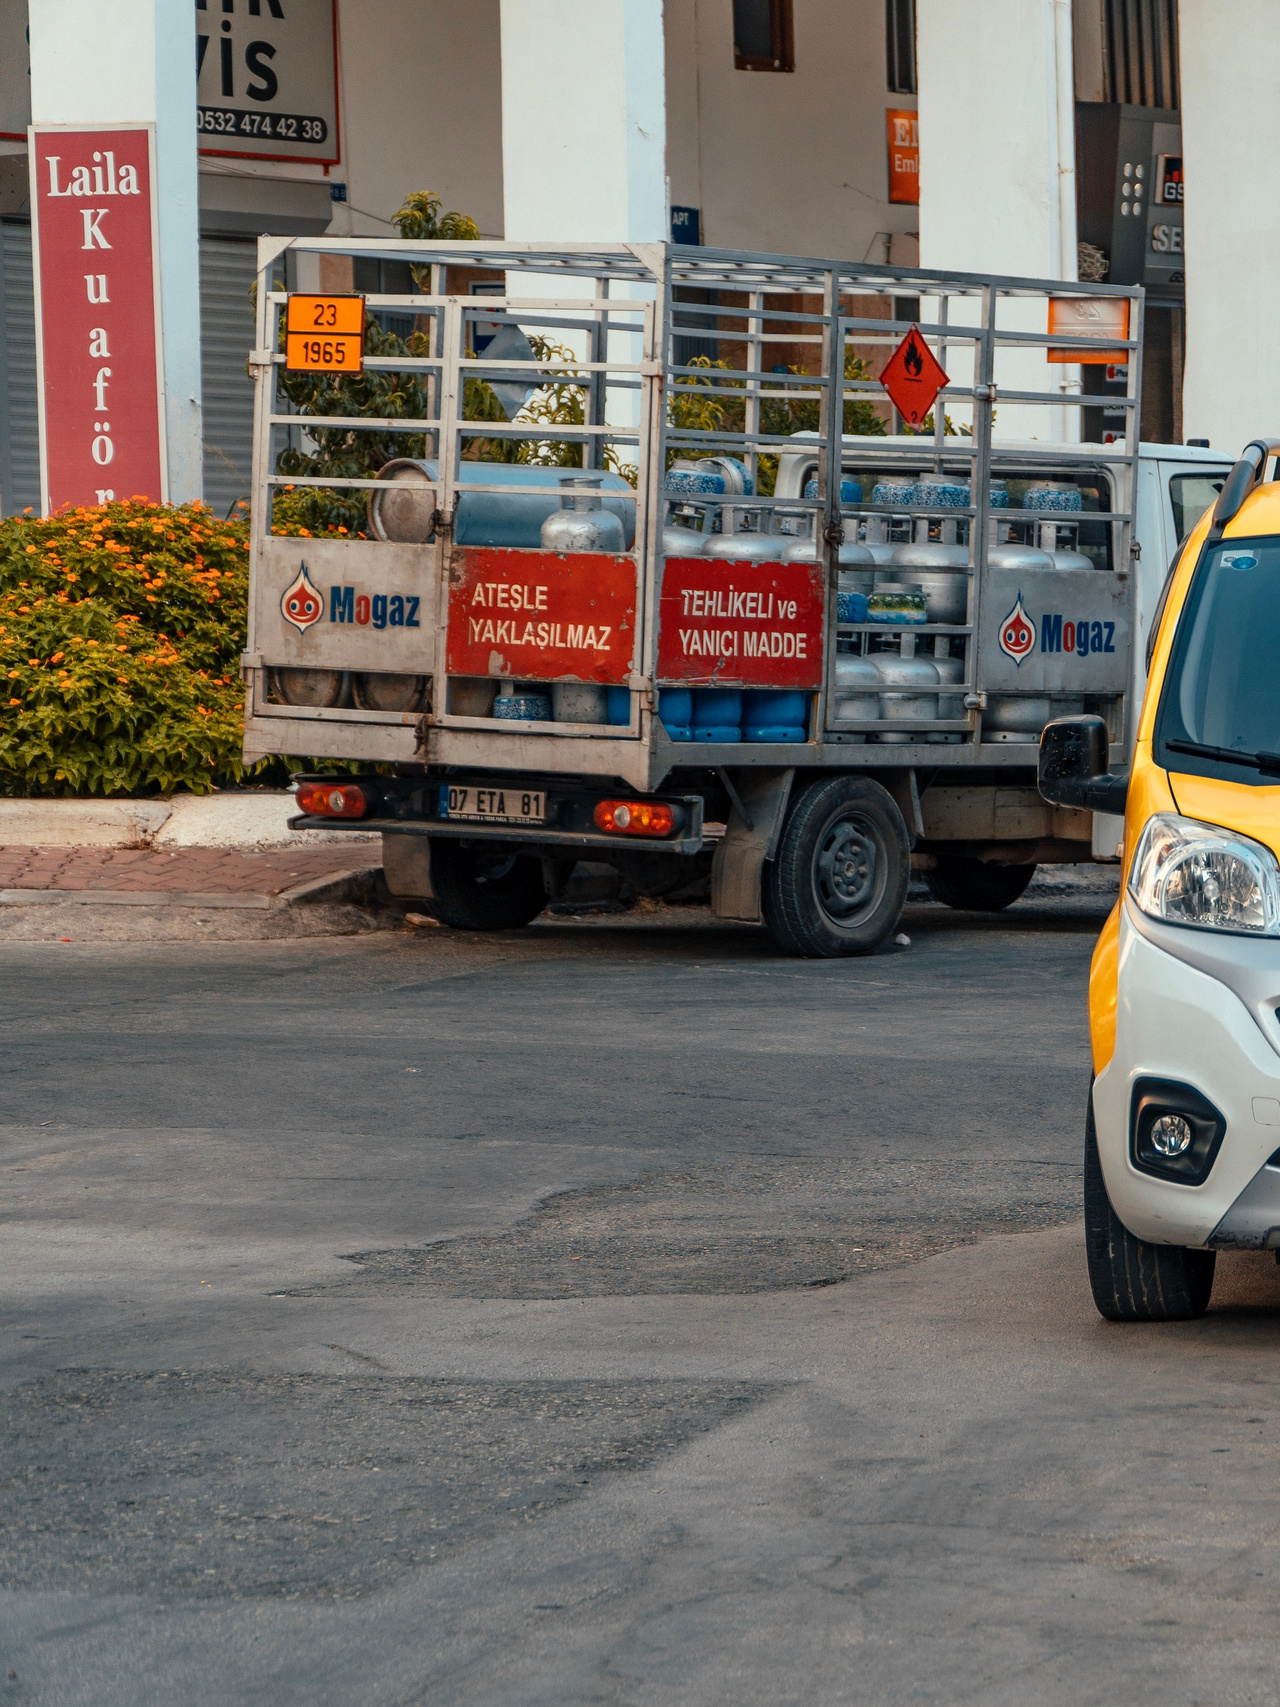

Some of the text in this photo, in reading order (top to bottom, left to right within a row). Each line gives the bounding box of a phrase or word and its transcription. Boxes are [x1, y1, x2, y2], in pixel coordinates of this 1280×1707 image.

[240, 114, 272, 135] 474
[276, 117, 297, 138] 42
[302, 120, 322, 139] 38
[45, 150, 141, 197] Laila
[672, 212, 688, 225] APT
[313, 303, 337, 326] 23
[303, 341, 346, 364] 1965
[911, 410, 918, 424] 2
[329, 586, 420, 629] Mogaz
[471, 582, 548, 611] ATEŞLE
[777, 600, 798, 619] ve
[468, 616, 611, 650] YAKLAŞILMAZ
[678, 629, 807, 658] YANICI MADDE
[1041, 614, 1115, 657] Mogaz
[448, 788, 540, 816] 07 ETA 81
